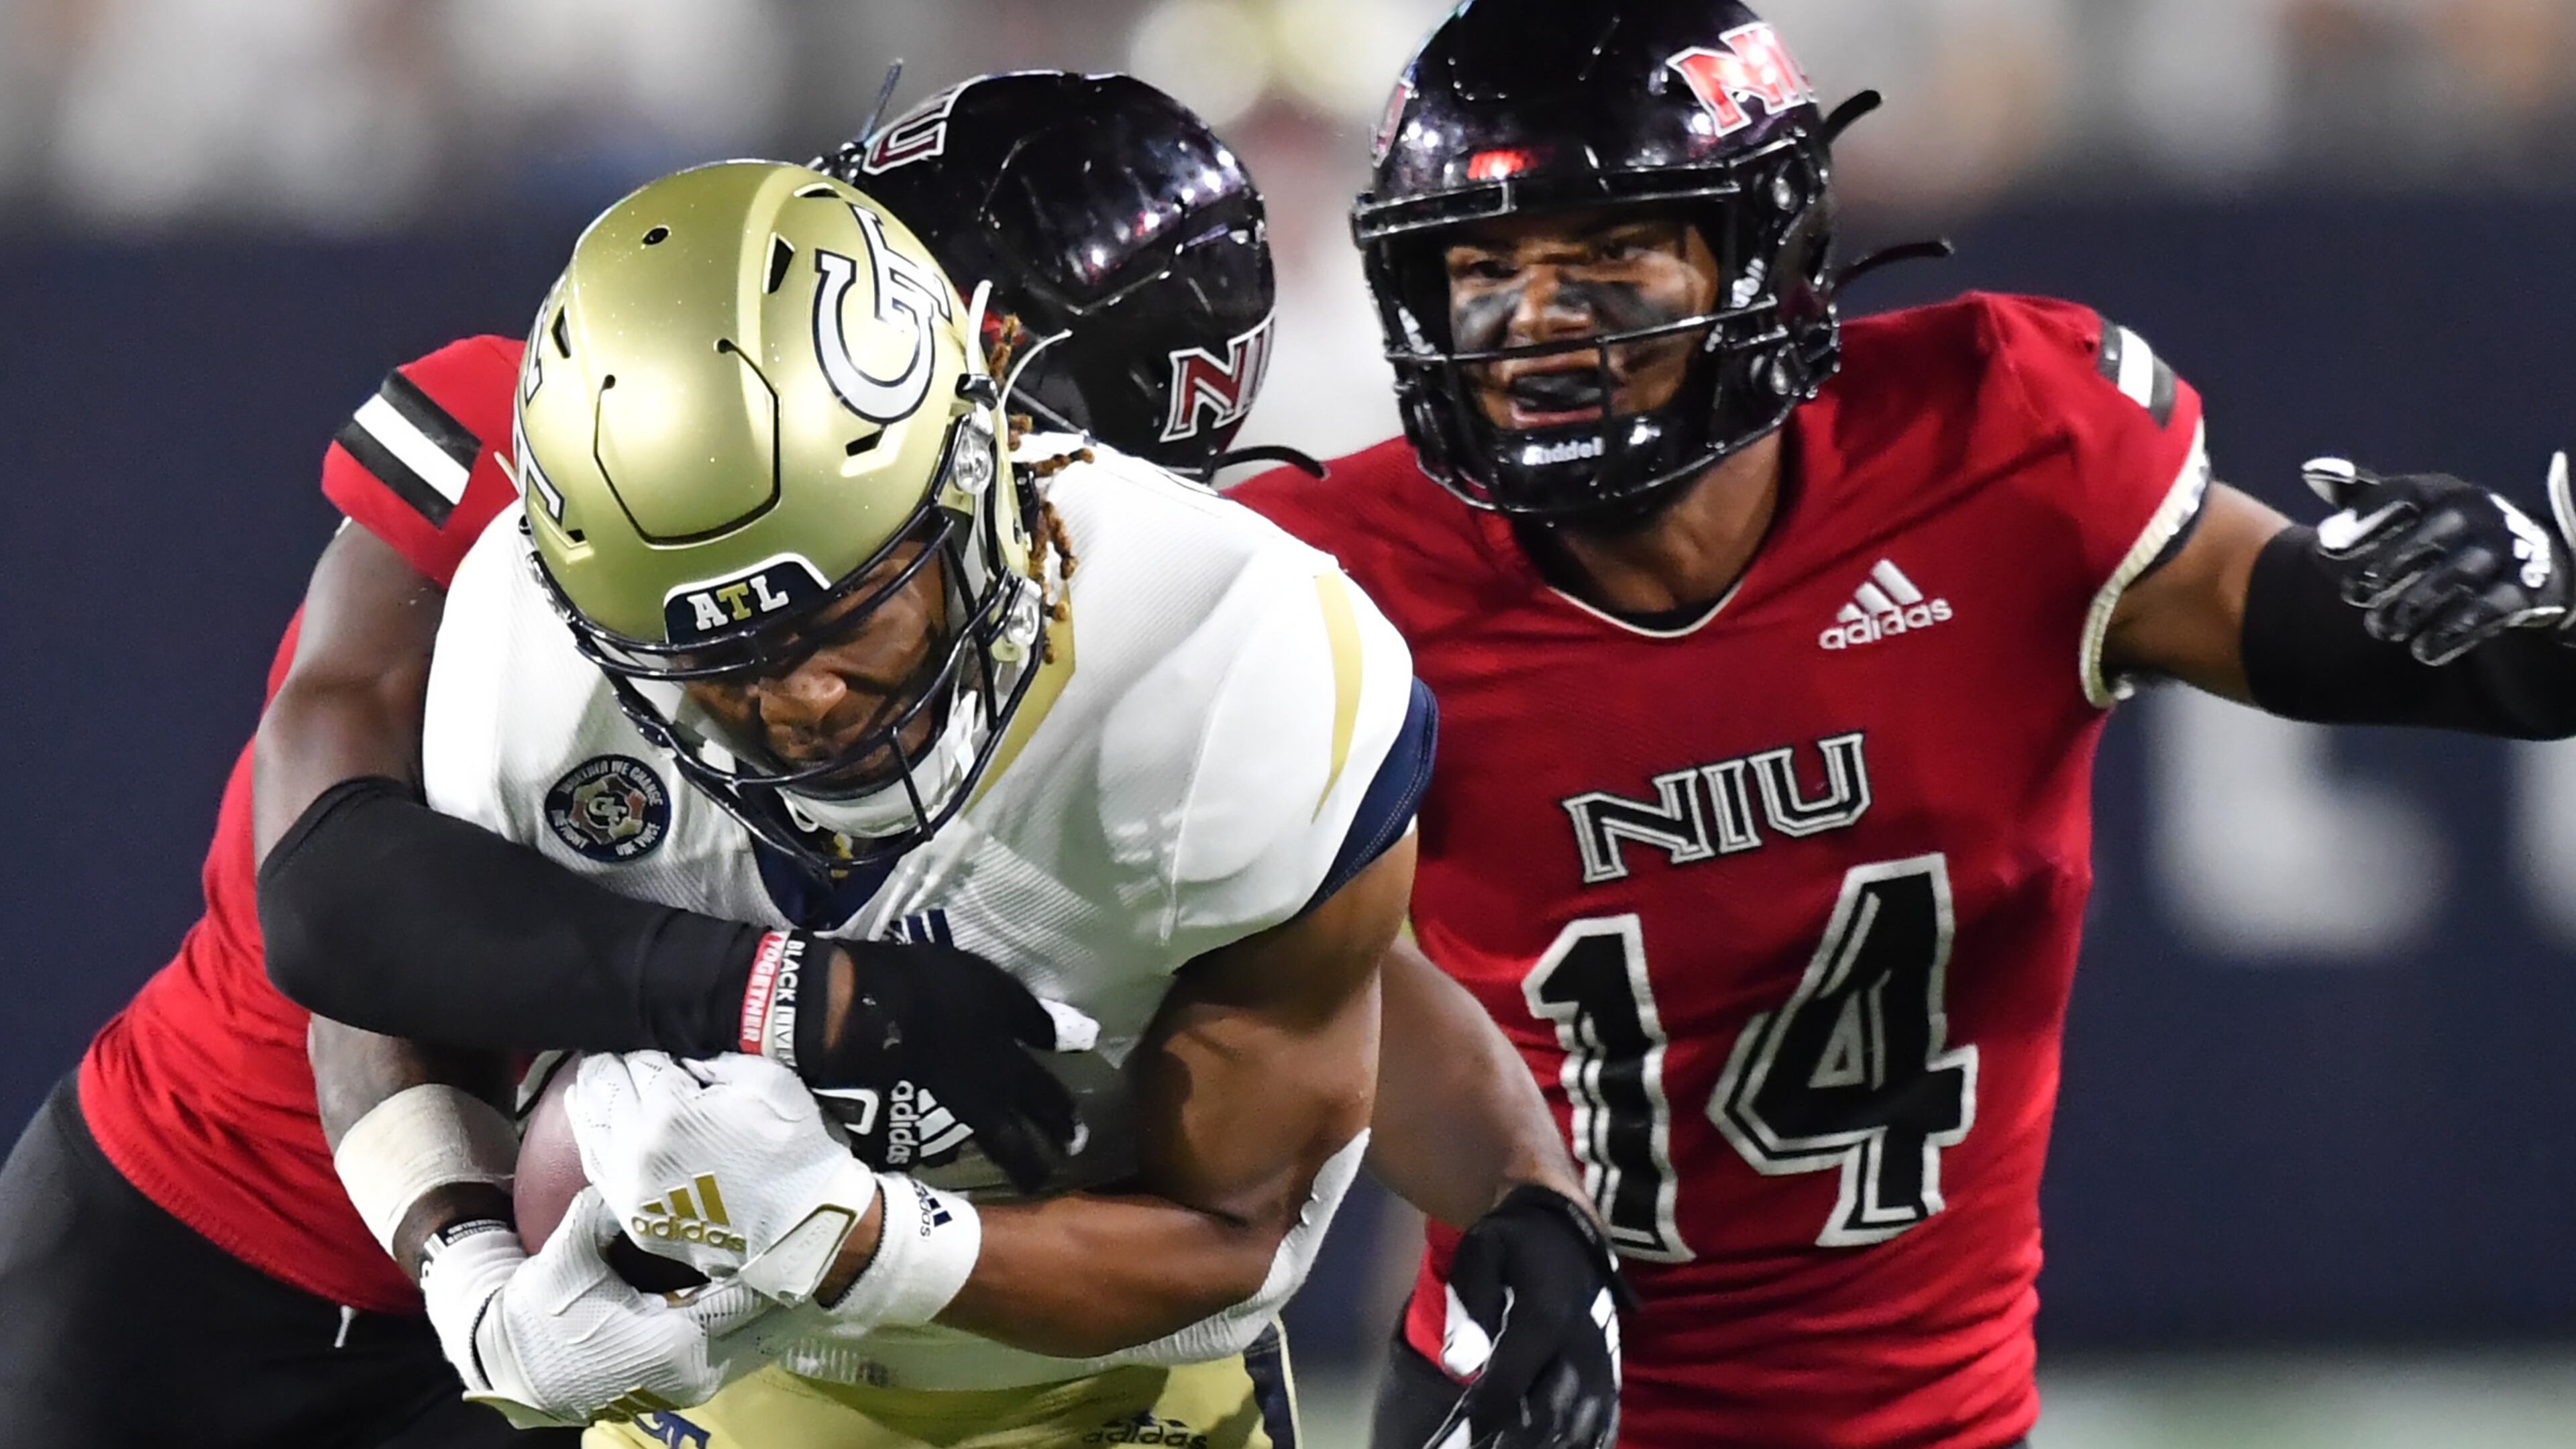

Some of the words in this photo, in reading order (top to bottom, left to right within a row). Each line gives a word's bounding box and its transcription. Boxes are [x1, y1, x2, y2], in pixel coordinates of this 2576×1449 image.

[687, 574, 789, 631] ATL
[1818, 598, 1953, 649] adidas
[611, 761, 631, 775] WE
[630, 766, 663, 806] CHANGE
[1562, 731, 1871, 883] NIU
[775, 940, 806, 1002] BLACK
[1521, 852, 1978, 1263] 14
[886, 1080, 921, 1164] adidas
[631, 1214, 747, 1254] adidas
[1081, 1423, 1208, 1449] adidas
